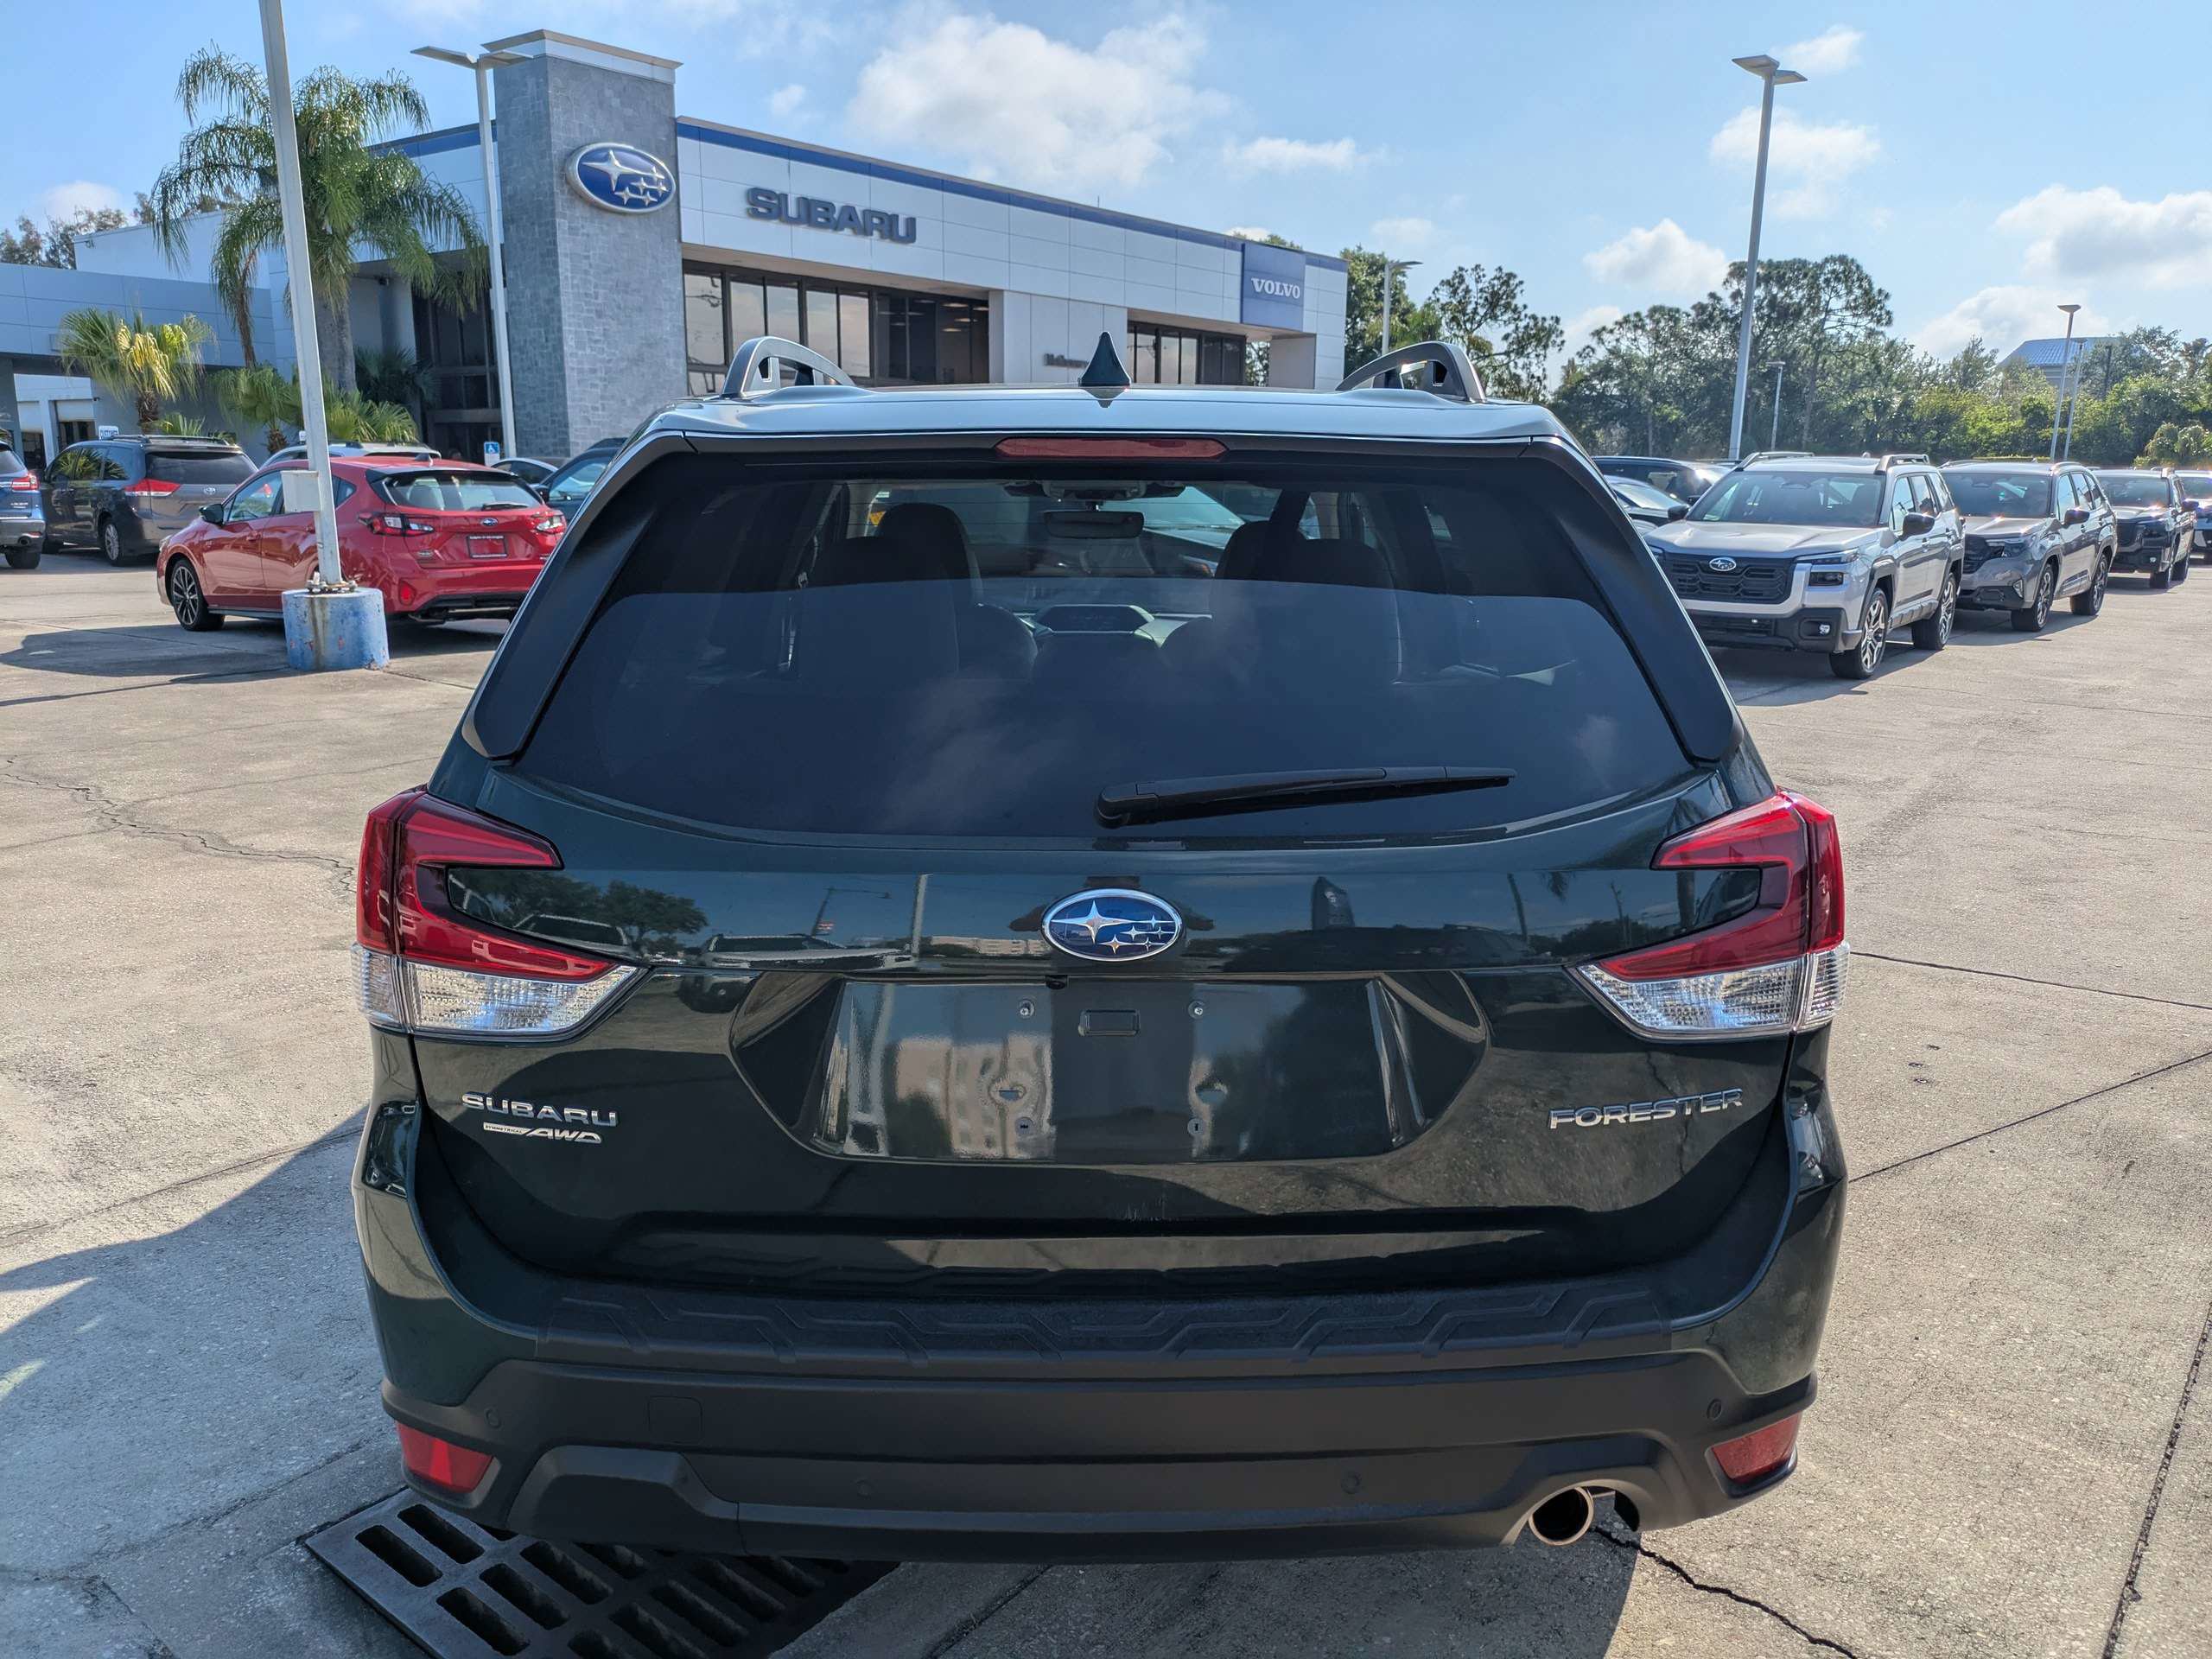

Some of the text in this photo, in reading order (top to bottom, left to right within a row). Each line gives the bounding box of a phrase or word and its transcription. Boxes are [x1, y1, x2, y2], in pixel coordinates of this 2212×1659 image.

[747, 187, 916, 244] SUBARU
[1251, 278, 1300, 299] VOLVO
[461, 1092, 618, 1127] SUBARU
[1549, 1088, 1743, 1129] FORESTER
[485, 1124, 602, 1144] SYMMETRICAL AWD
